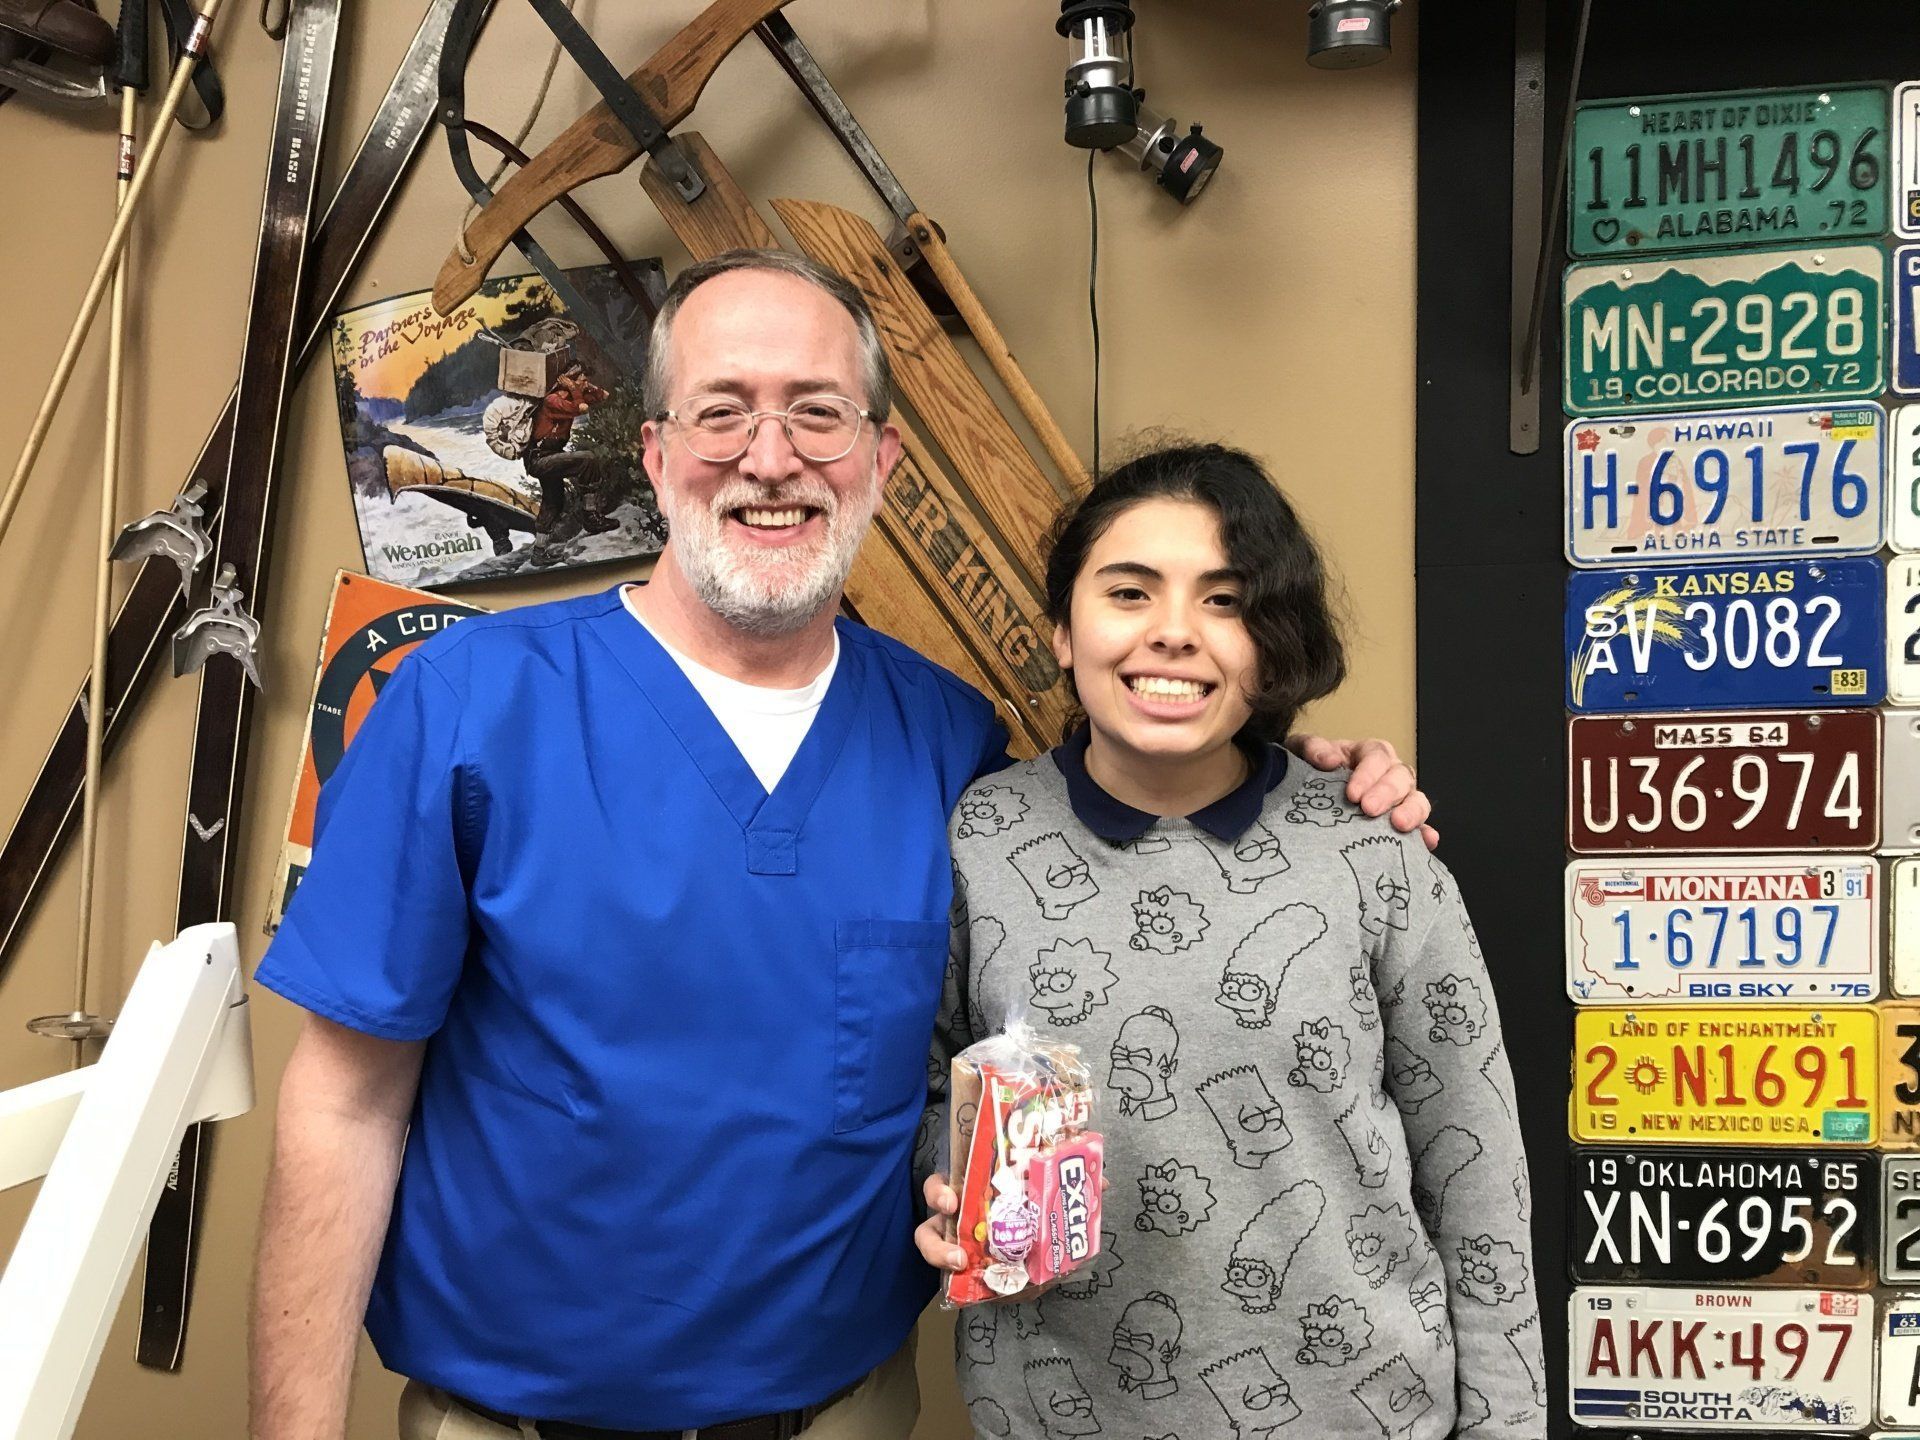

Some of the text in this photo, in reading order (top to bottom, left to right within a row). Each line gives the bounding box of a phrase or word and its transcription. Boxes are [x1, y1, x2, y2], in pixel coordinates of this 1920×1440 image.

[1642, 102, 1817, 134] HEART OF DIXIE
[1587, 127, 1880, 210] 11MH1496
[1657, 206, 1800, 239] ALABAMA
[358, 306, 432, 354] Partners
[359, 307, 477, 369] in the Voyage
[1582, 288, 1864, 373] MN-2928
[1587, 363, 1861, 401] 19 COLORADO 72
[1674, 420, 1773, 442] HAWAII
[1857, 411, 1873, 425] 80
[1583, 440, 1868, 530] H-69176
[1643, 528, 1805, 551] ALOHA STATE
[1654, 570, 1796, 598] KANSAS
[946, 544, 1038, 668] KING
[367, 629, 387, 652] A
[1683, 596, 1843, 671] 3082
[1840, 671, 1859, 687] 83
[317, 702, 342, 716] TRADE
[1657, 726, 1784, 746] MASS 64
[1654, 870, 1862, 900] MONTANA 3 91
[1689, 983, 1733, 997] BIG
[1739, 983, 1795, 997] SKY
[1609, 1021, 1838, 1038] LAND OF ENCHANTMENT
[1585, 1044, 1868, 1108] 2 N1691
[1589, 1113, 1810, 1132] 19 NEW MEXICO USA
[1588, 1159, 1858, 1190] 19 OKLAHOMA 65
[1059, 1156, 1090, 1262] Extra
[1583, 1190, 1858, 1265] XN-6952
[1587, 1293, 1858, 1311] 19 BROWN 82
[1899, 1317, 1917, 1327] 65
[1644, 1390, 1732, 1405] SOUTH
[1644, 1405, 1753, 1420] DAKOTA
